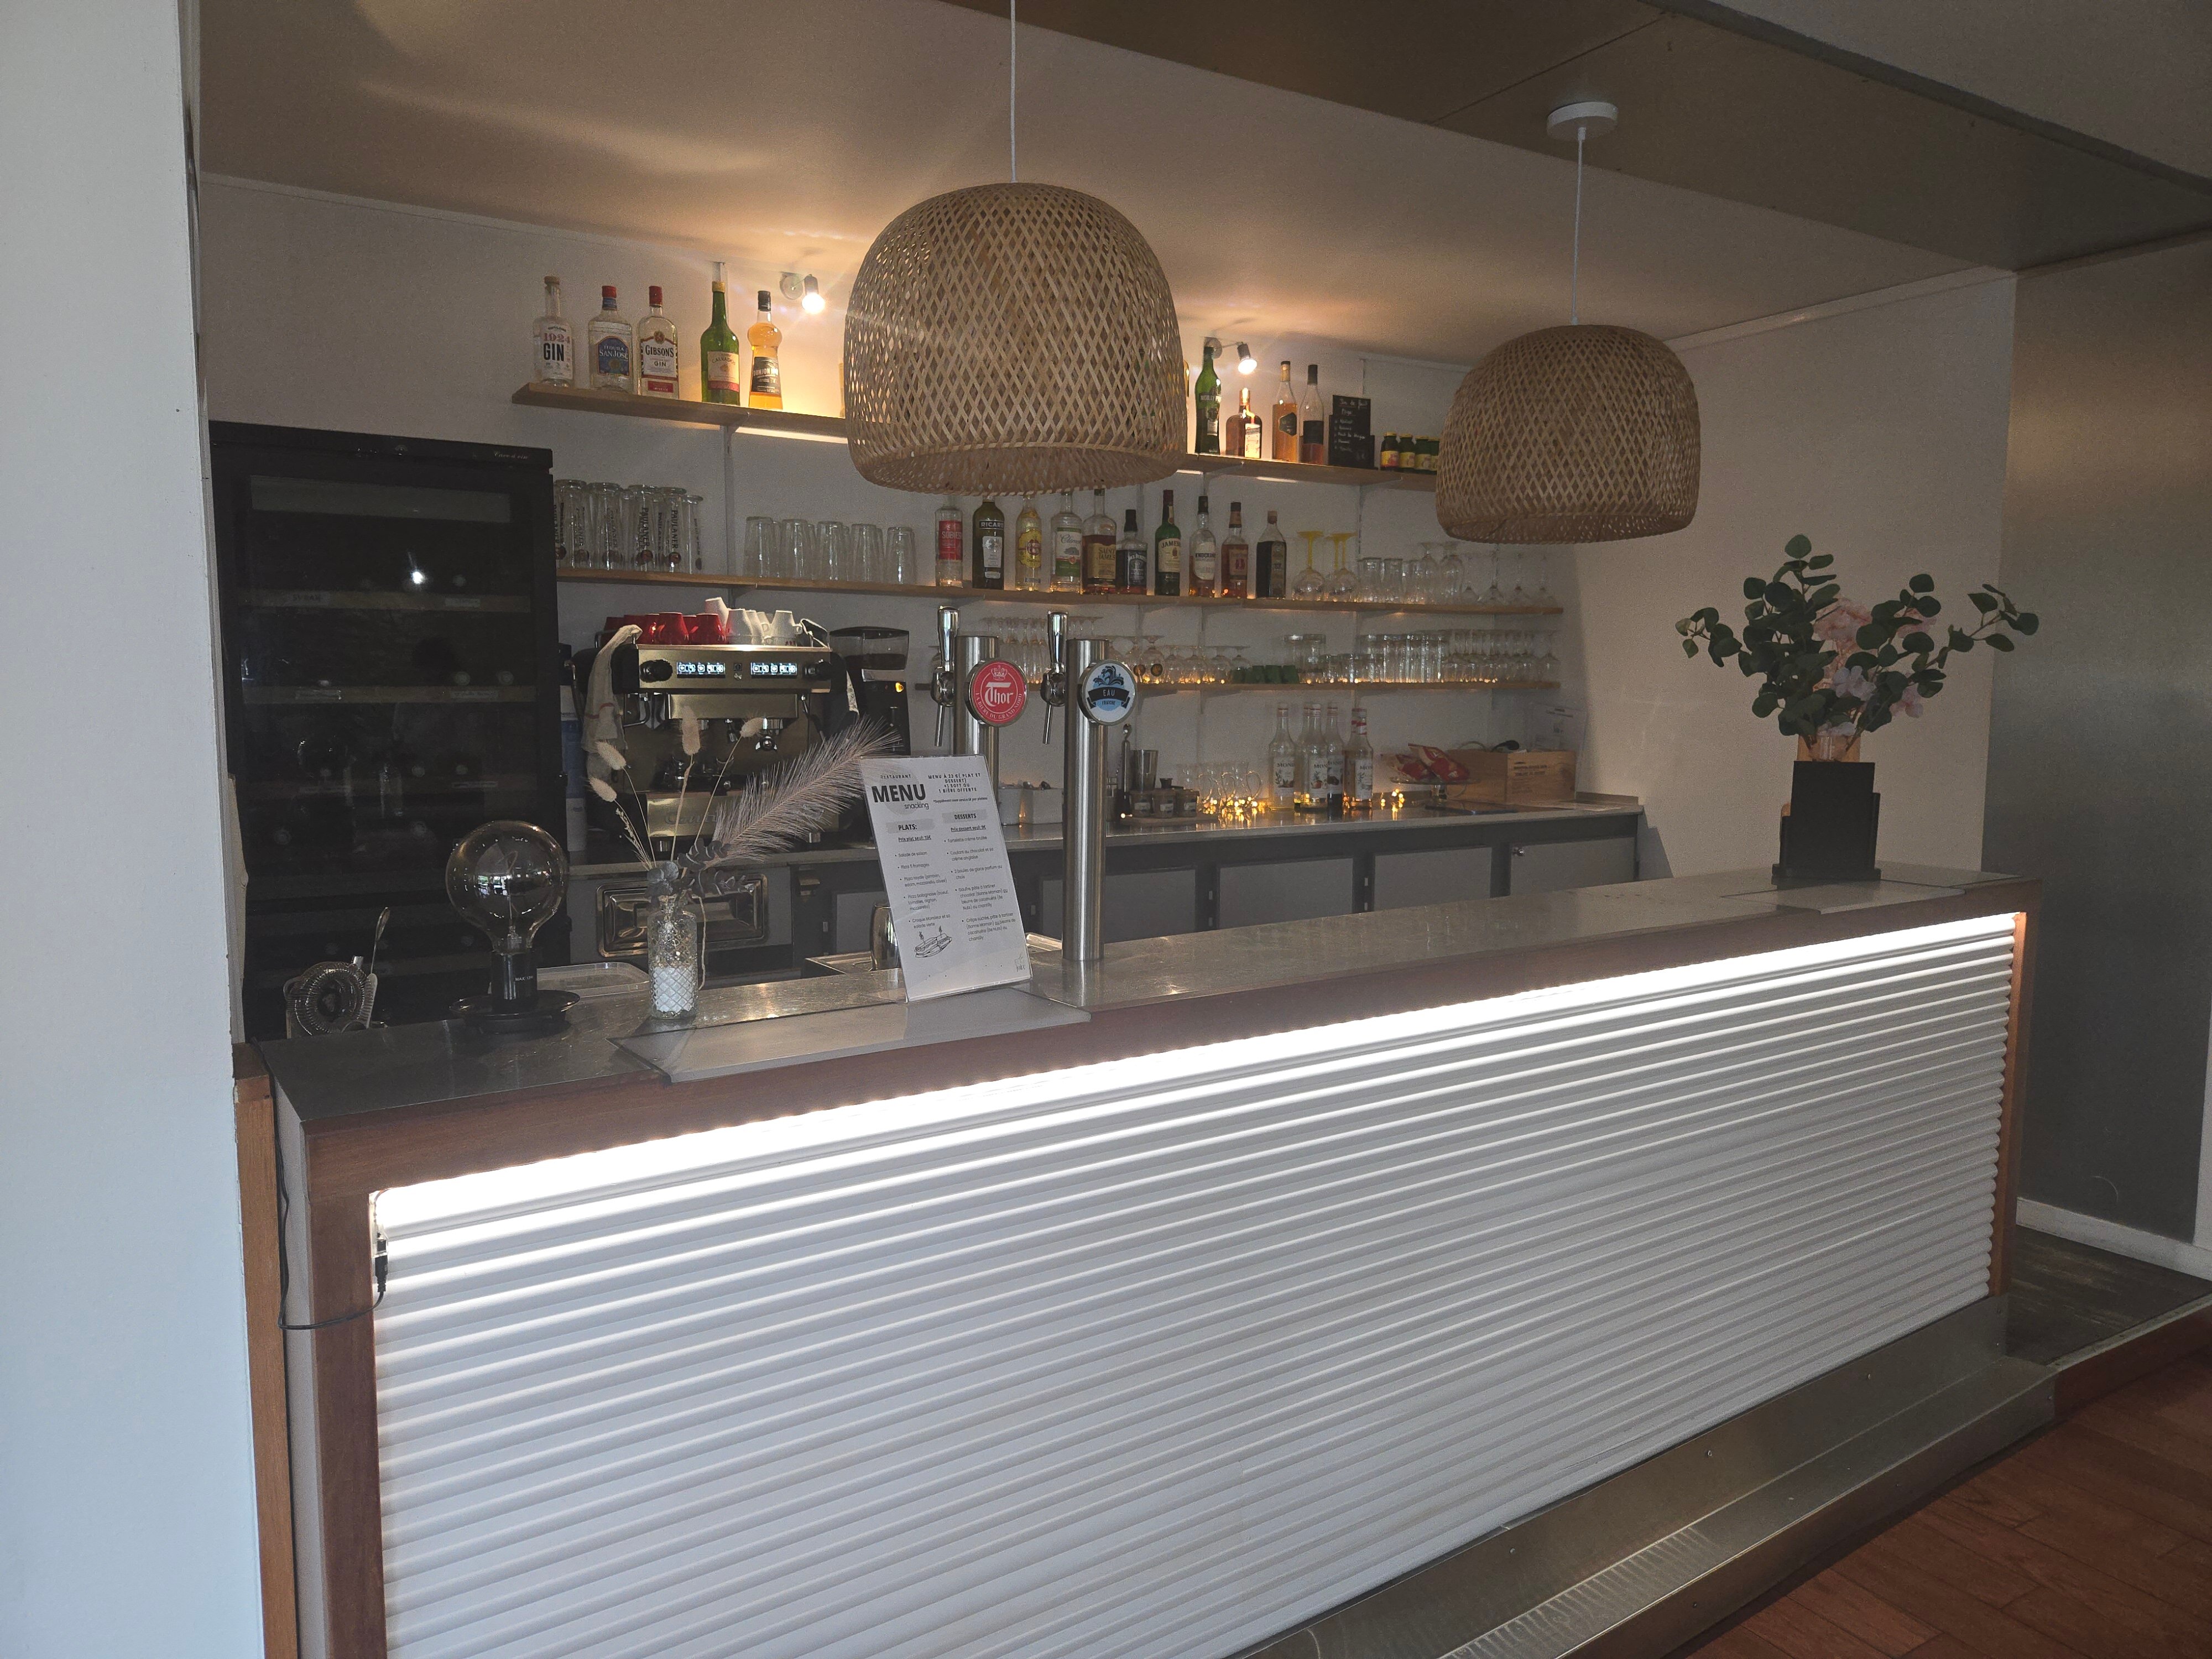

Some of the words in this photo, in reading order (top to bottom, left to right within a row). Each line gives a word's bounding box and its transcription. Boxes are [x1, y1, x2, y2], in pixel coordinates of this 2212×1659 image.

[544, 343, 564, 362] GIN
[942, 531, 962, 539] SOBIES
[984, 682, 1014, 707] Thor
[998, 708, 1015, 719] GRAND
[1014, 693, 1022, 708] NORD
[872, 784, 926, 804] MENU
[904, 802, 930, 810] snacking
